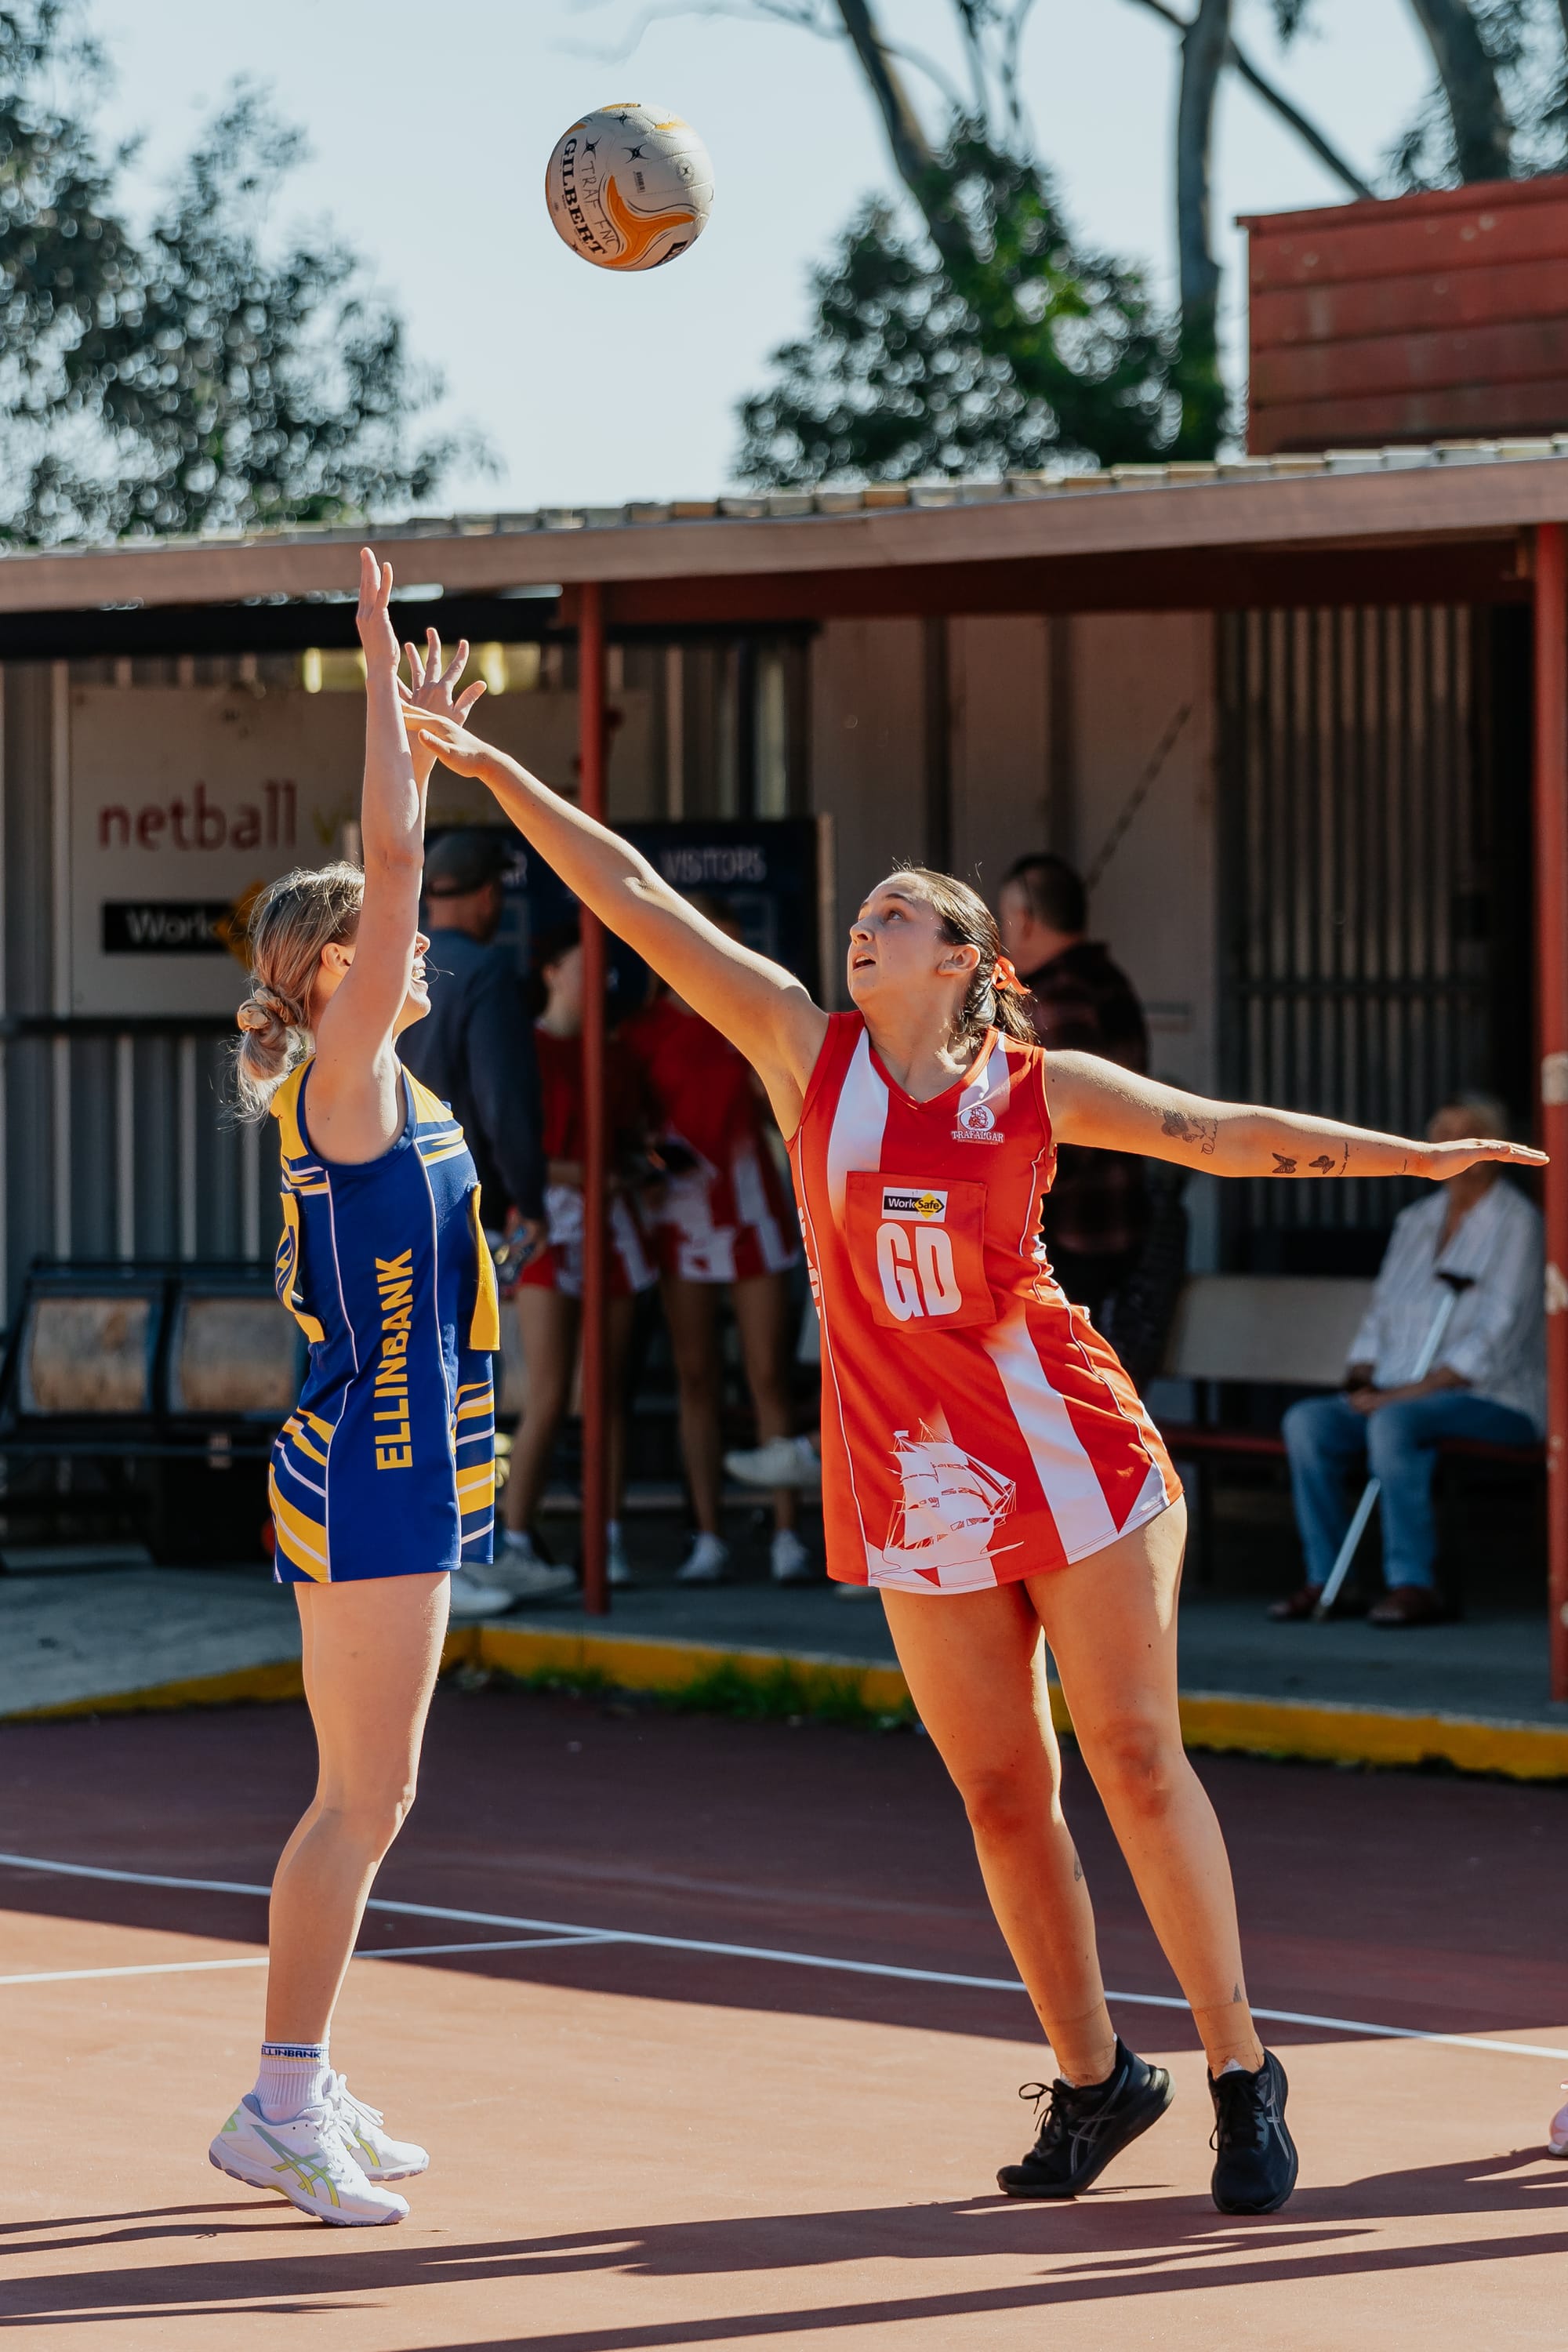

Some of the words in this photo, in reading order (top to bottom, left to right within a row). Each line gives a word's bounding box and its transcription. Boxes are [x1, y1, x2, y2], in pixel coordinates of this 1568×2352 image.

[562, 138, 608, 255] GILBERT
[581, 160, 600, 209] TRAF
[98, 780, 298, 851] netball
[662, 847, 766, 883] VISITORS
[951, 1131, 1004, 1143] TRAFALGAR
[888, 1198, 915, 1209] Work
[918, 1200, 939, 1210] Safe
[876, 1222, 962, 1321] GD
[374, 1248, 413, 1470] ELLINBANK
